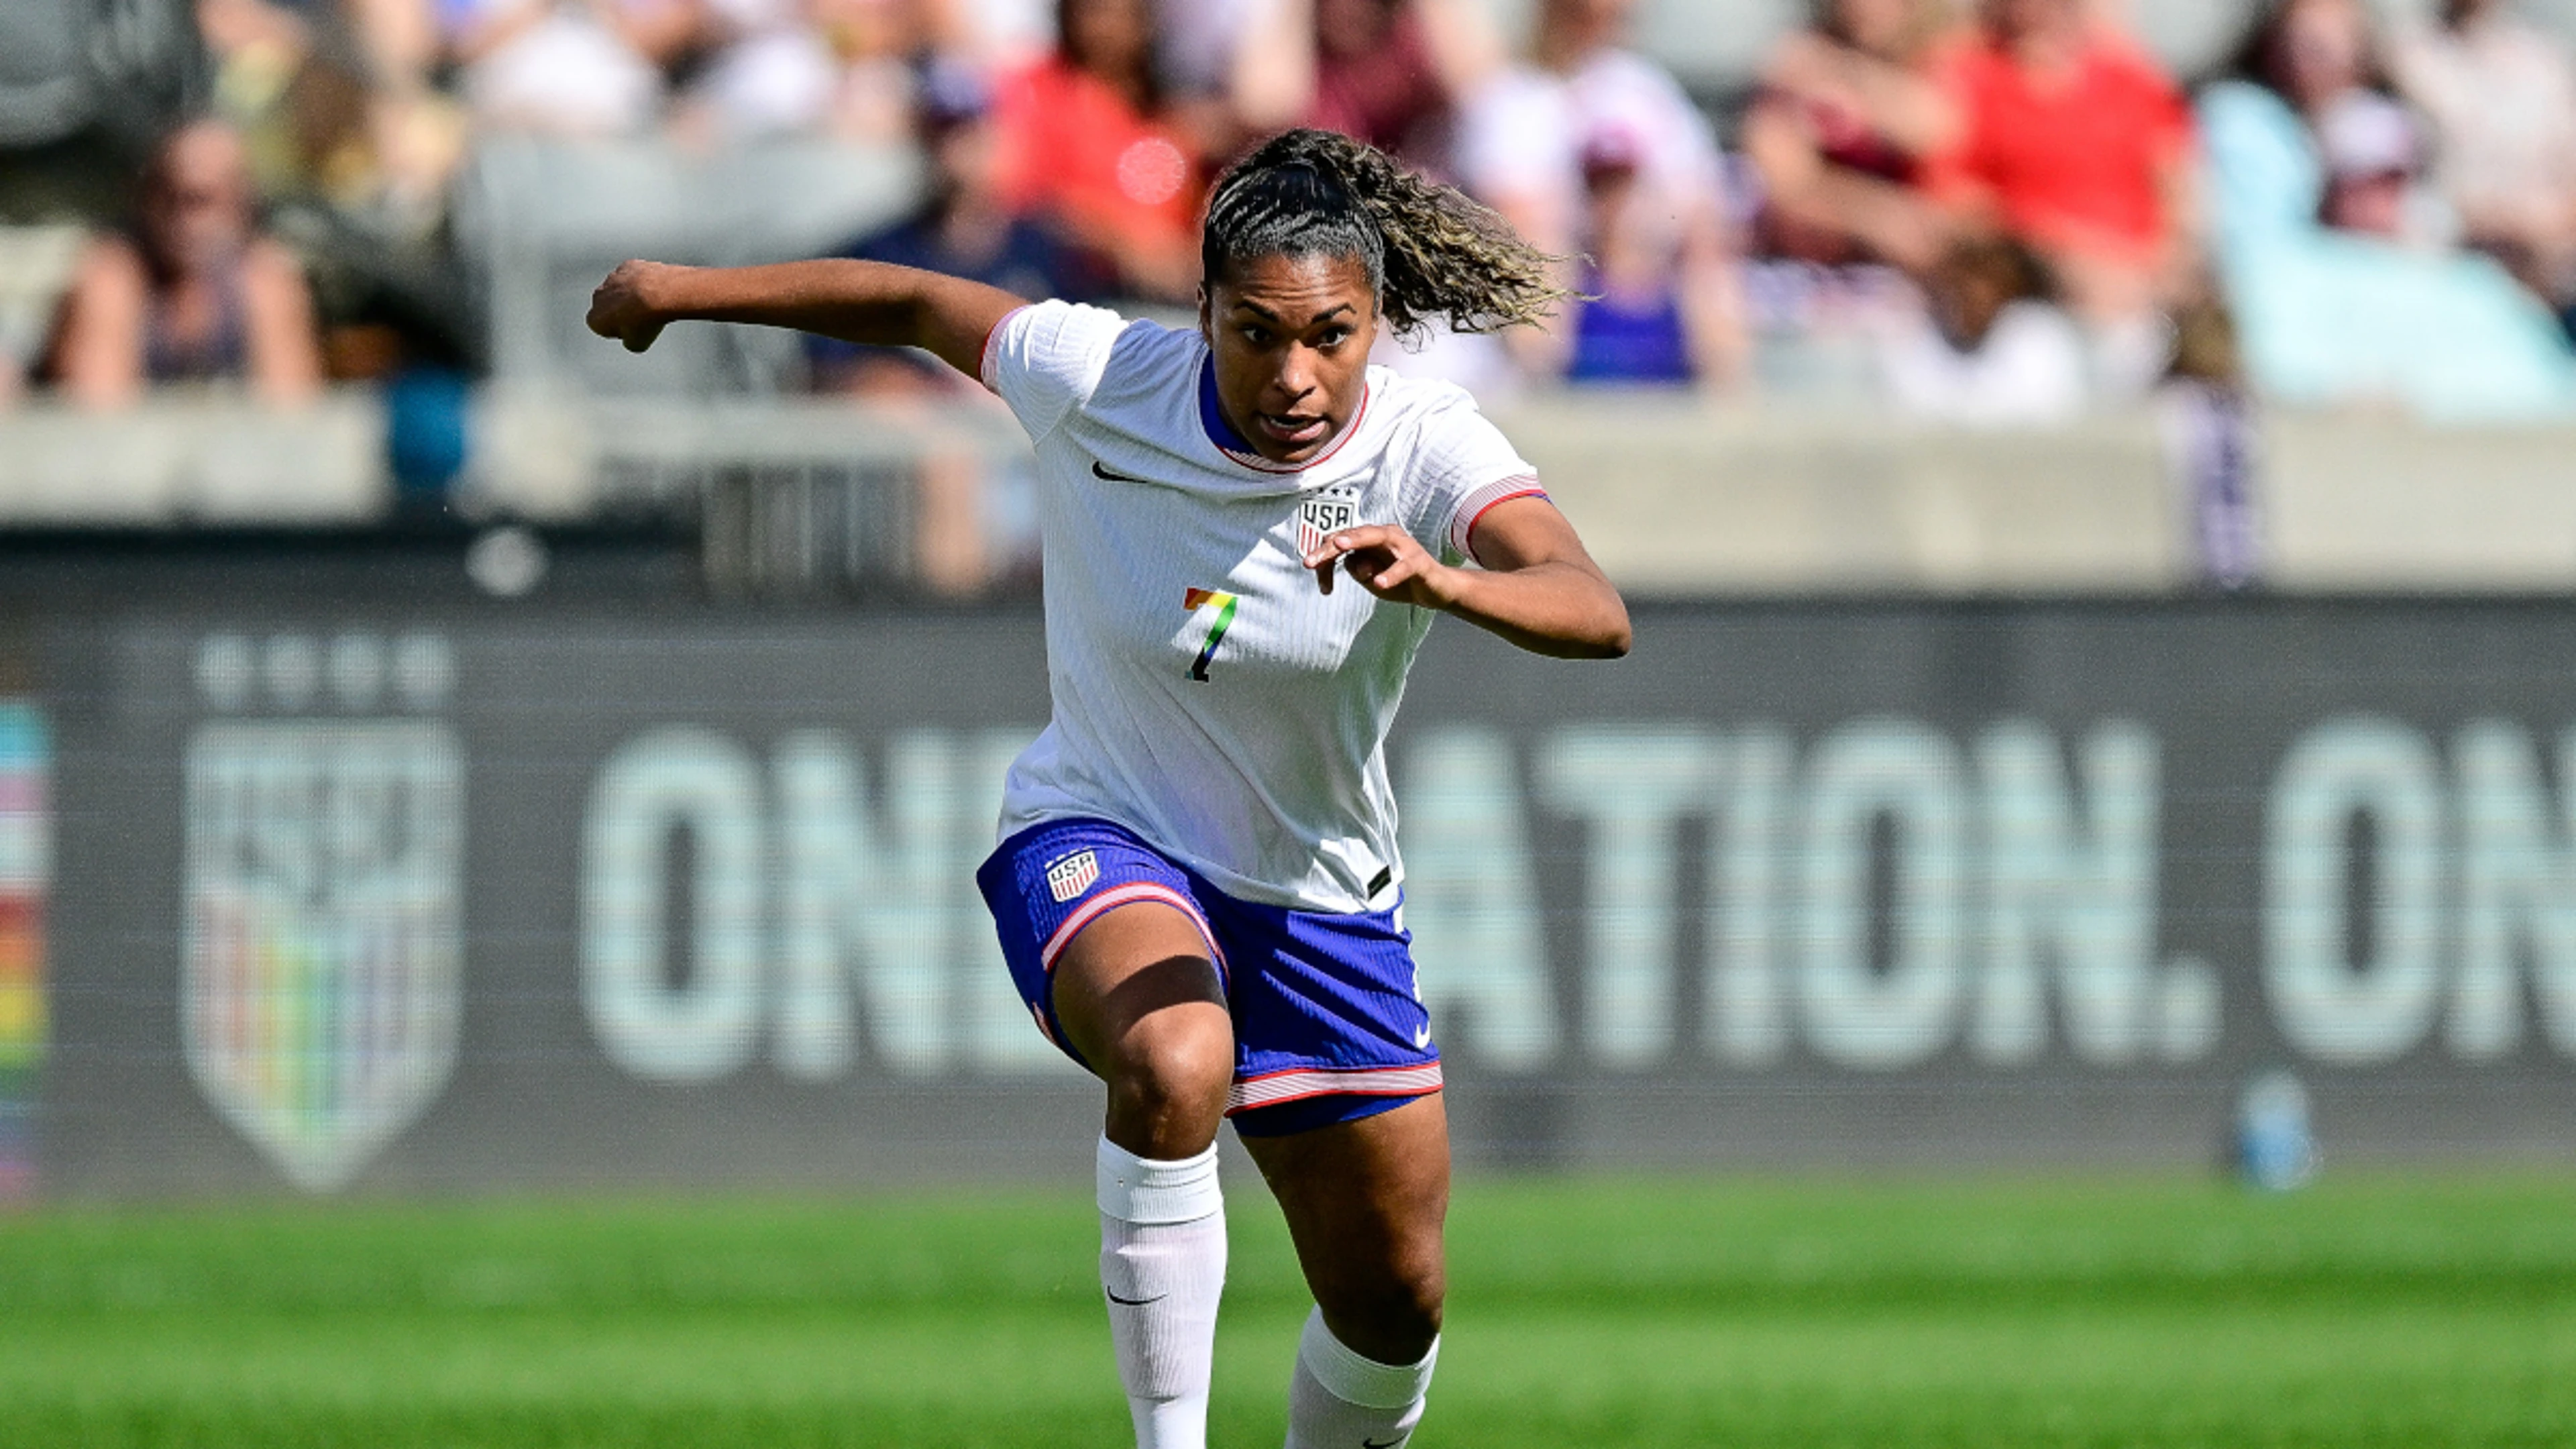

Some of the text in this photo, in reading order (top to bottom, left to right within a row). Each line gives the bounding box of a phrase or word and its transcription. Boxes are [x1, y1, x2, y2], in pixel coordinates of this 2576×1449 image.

[1304, 502, 1349, 531] USA
[1184, 588, 1238, 683] 7
[1051, 854, 1091, 882] USA
[1395, 726, 2219, 1072] ATION.
